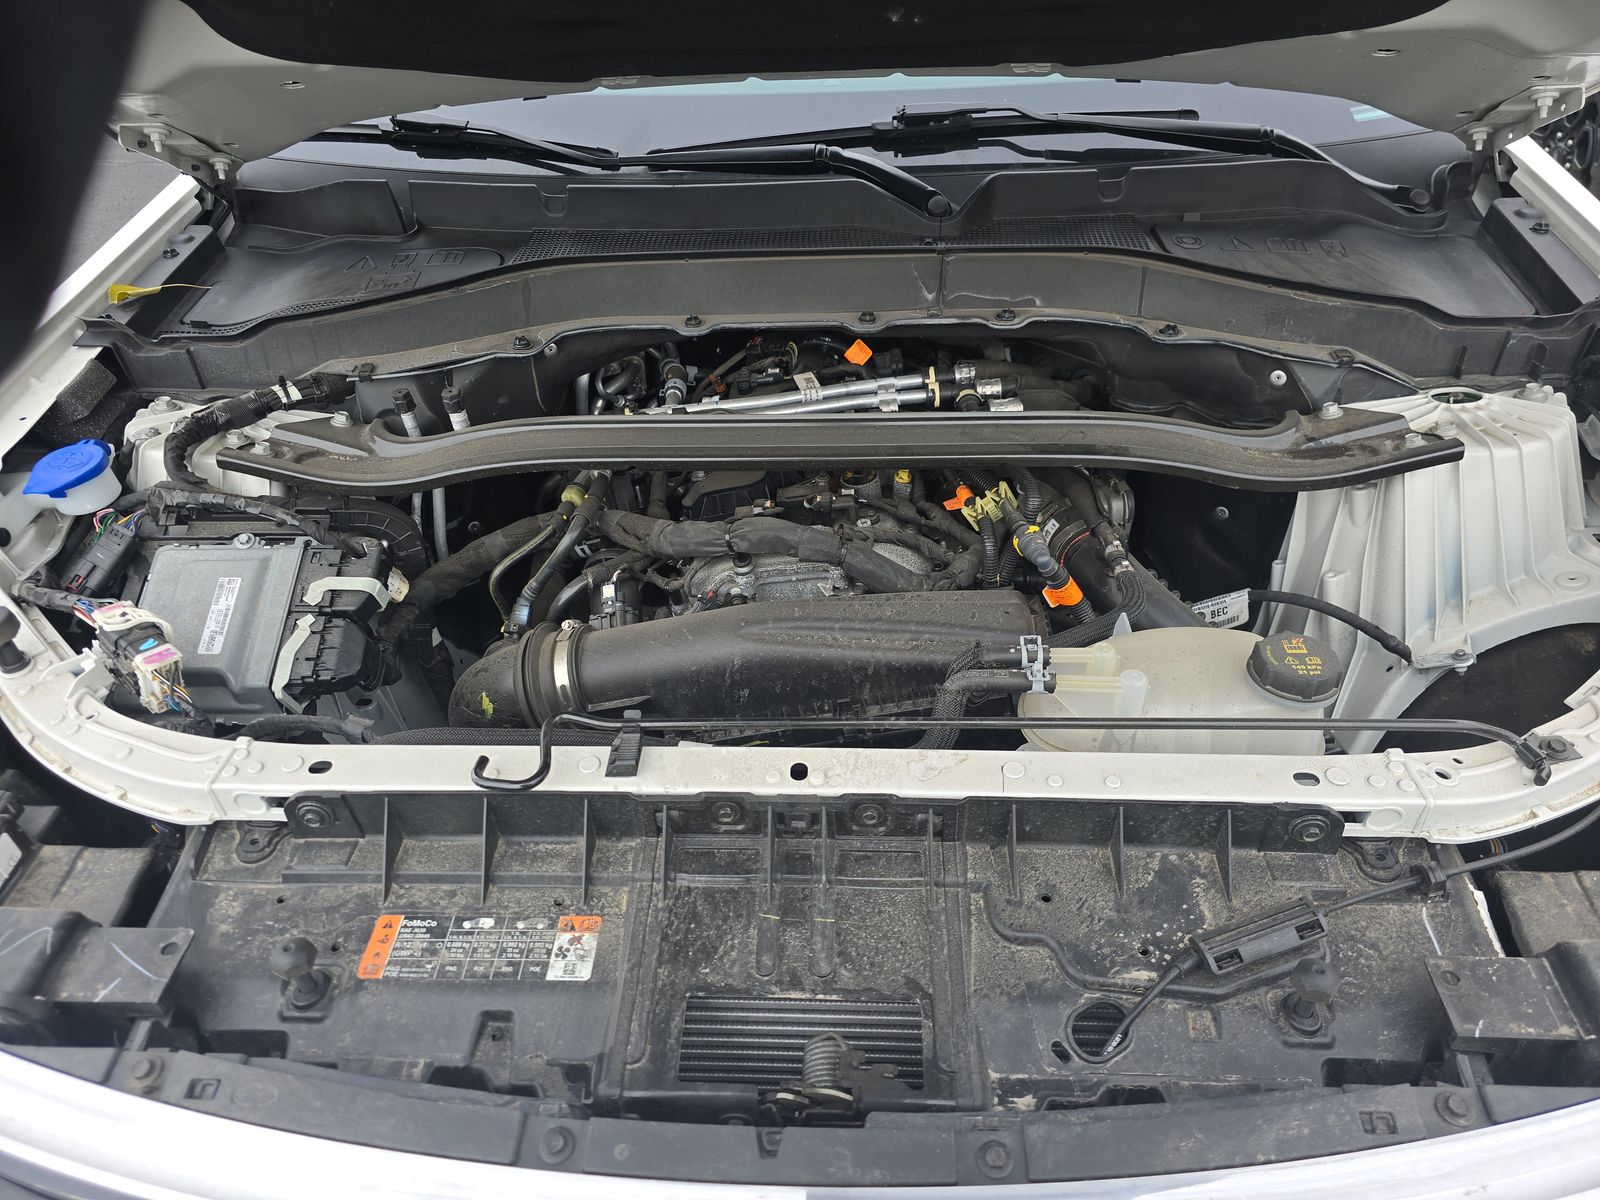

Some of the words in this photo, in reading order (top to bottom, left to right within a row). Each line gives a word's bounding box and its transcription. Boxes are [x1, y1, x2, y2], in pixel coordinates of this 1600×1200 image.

[1210, 606, 1228, 619] BEC
[401, 919, 438, 927] FoMoCo
[463, 941, 470, 949] kg
